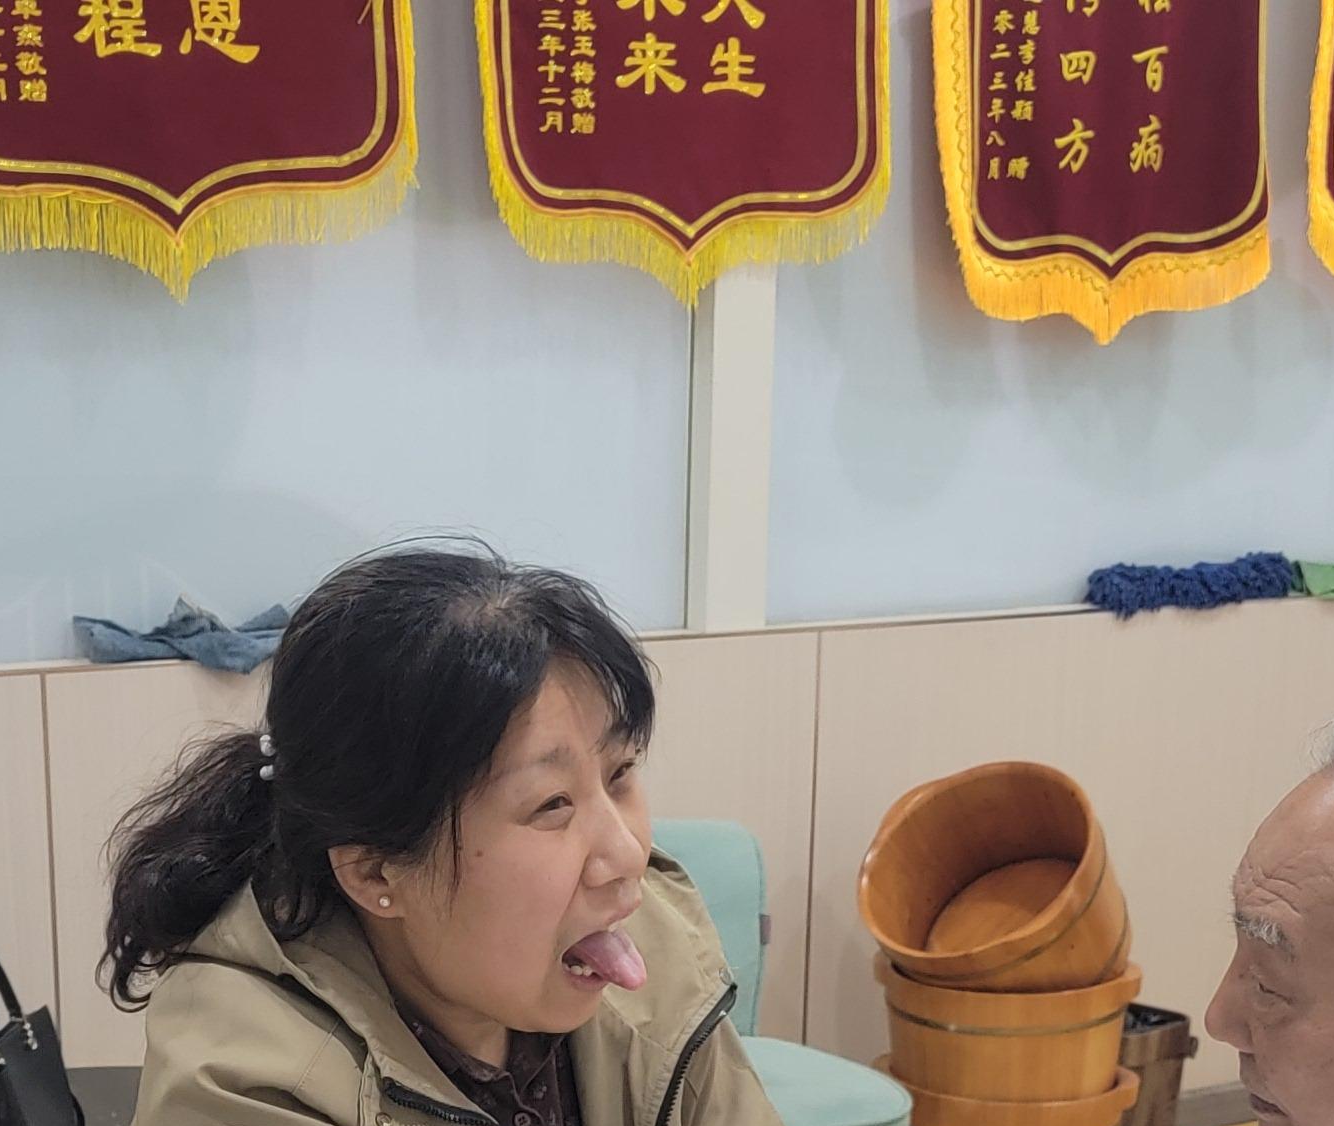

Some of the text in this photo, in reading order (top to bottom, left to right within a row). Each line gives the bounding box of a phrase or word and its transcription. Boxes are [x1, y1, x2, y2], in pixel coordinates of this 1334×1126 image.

[537, 0, 566, 134] 三年十二月
[570, 0, 598, 134] 张玉梅敬赠
